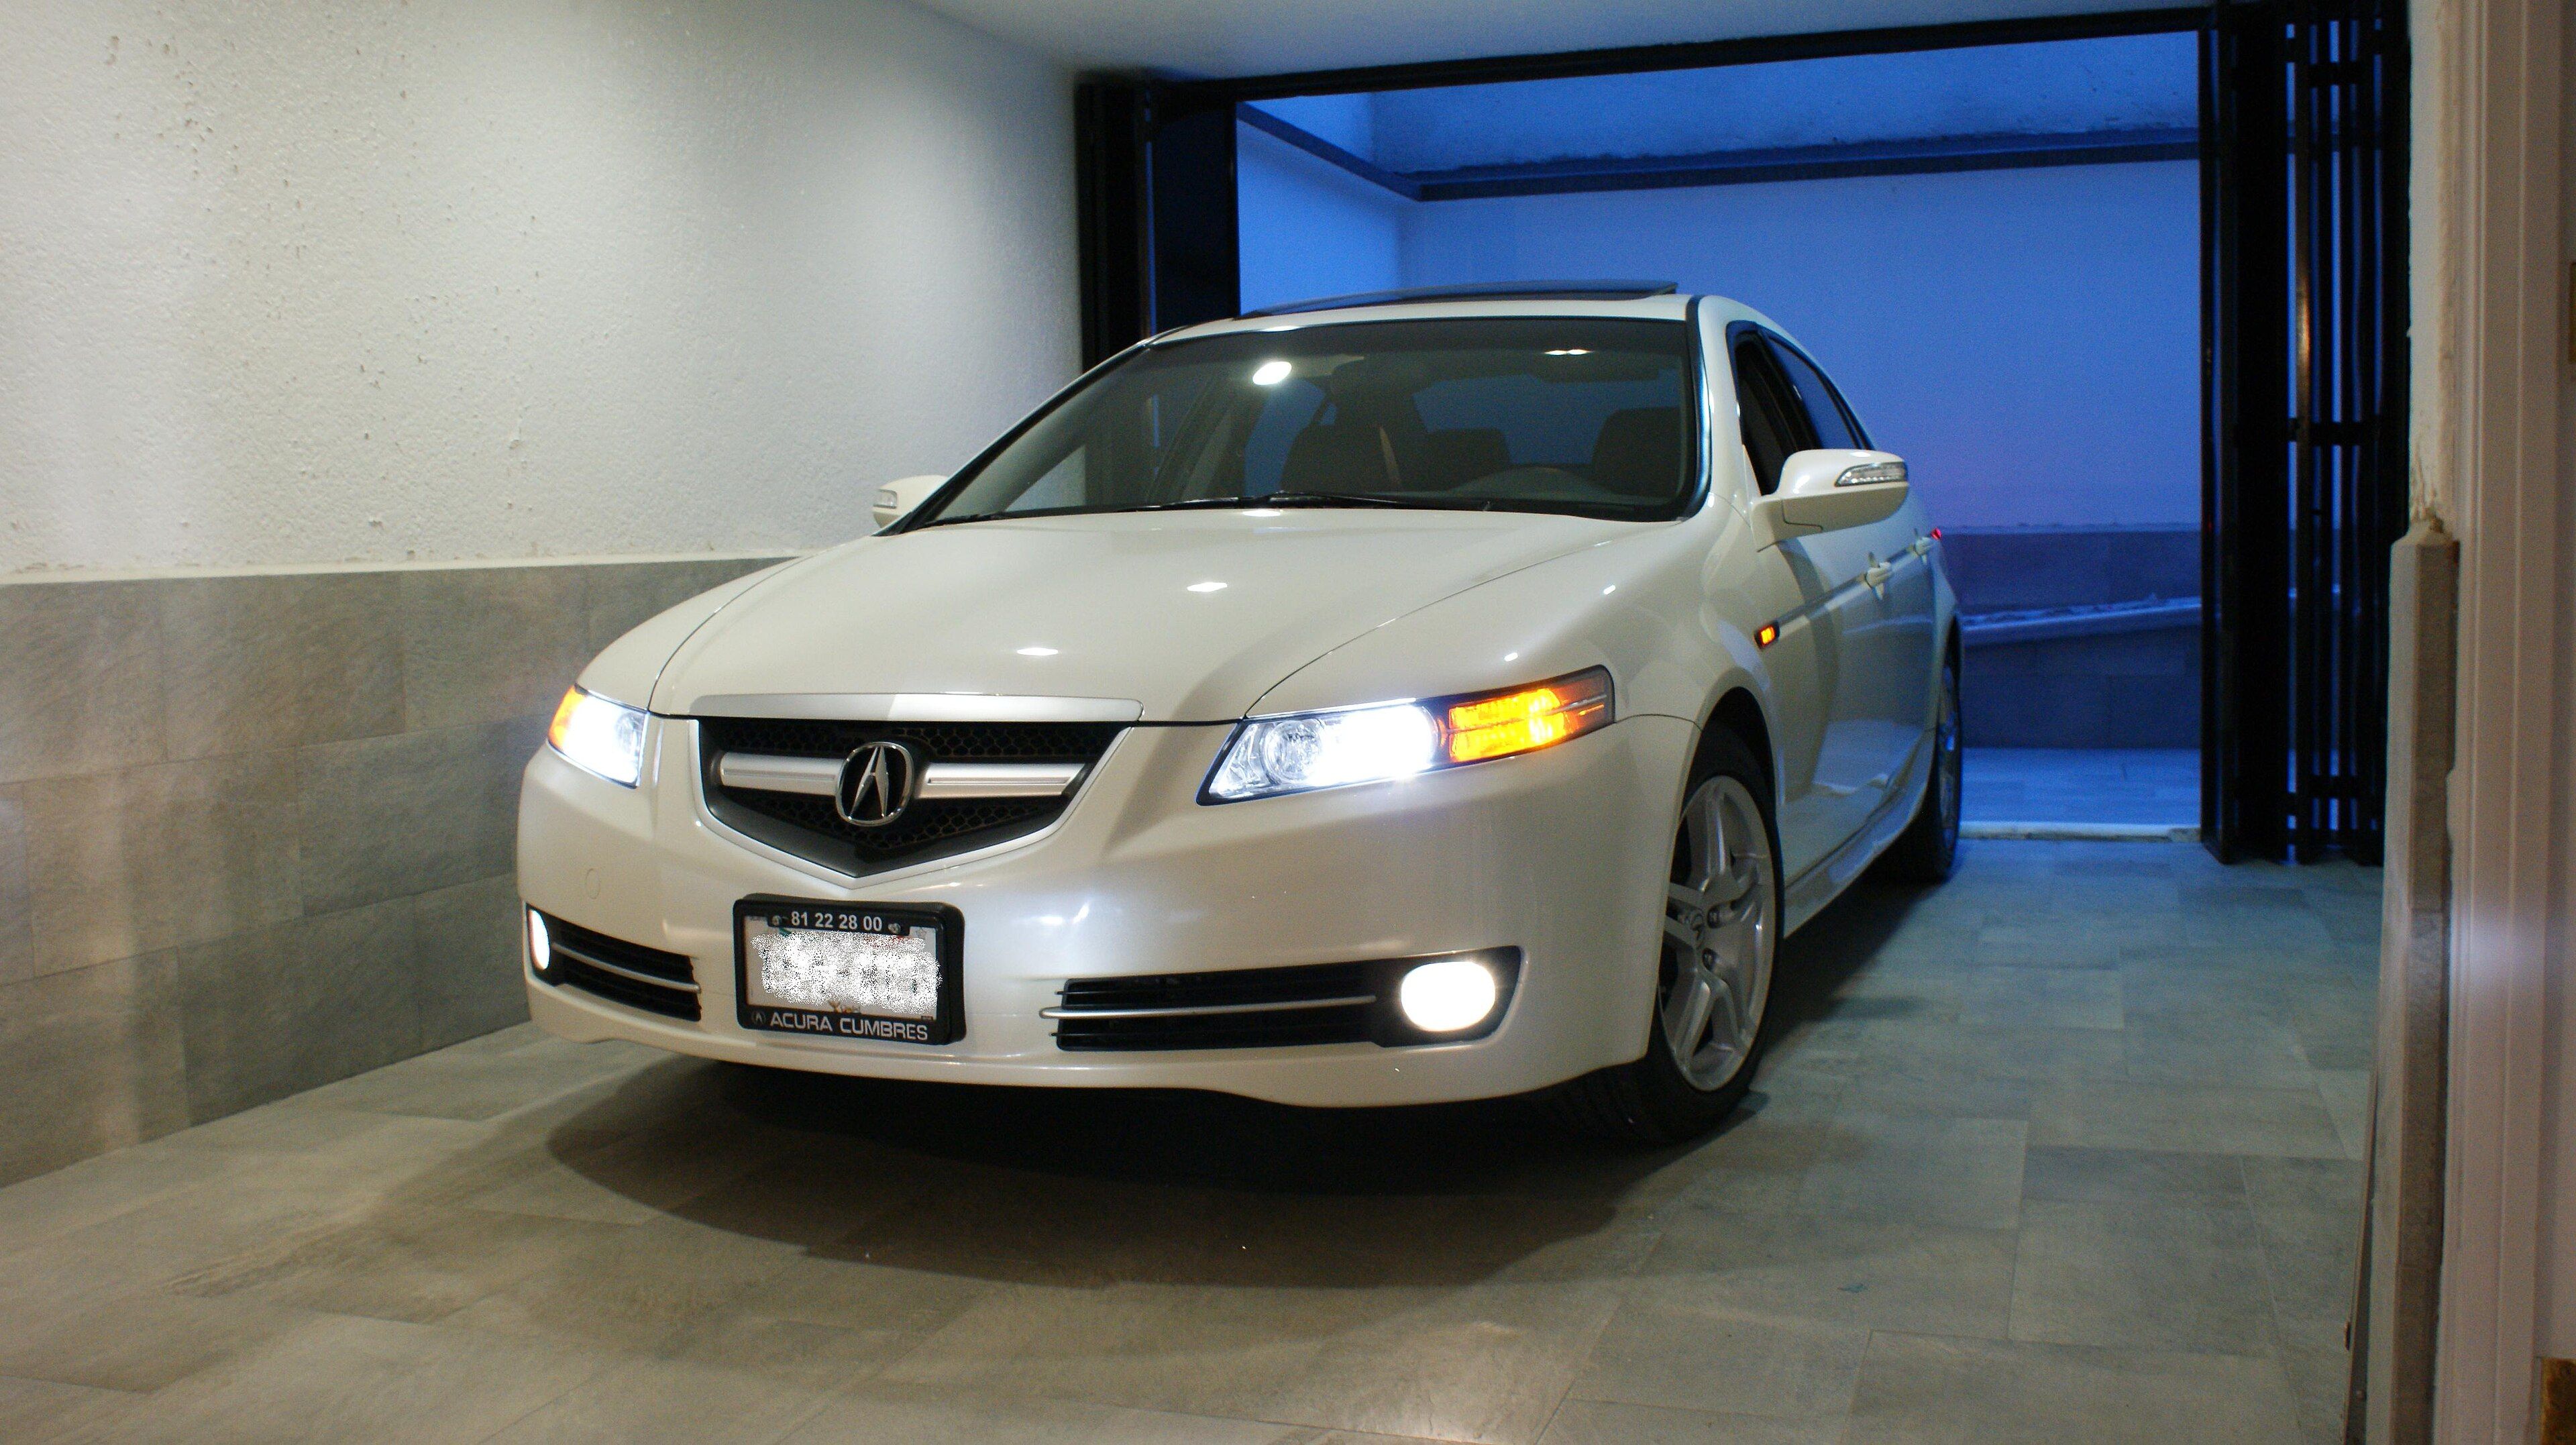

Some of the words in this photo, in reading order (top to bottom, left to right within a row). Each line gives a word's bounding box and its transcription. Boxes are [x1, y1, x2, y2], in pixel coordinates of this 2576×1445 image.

[792, 911, 808, 926] 81
[815, 913, 833, 928] 22
[839, 914, 857, 930] 28
[863, 916, 882, 931] 00
[771, 1012, 833, 1032] ACURA
[840, 1018, 928, 1040] CUMBRES
